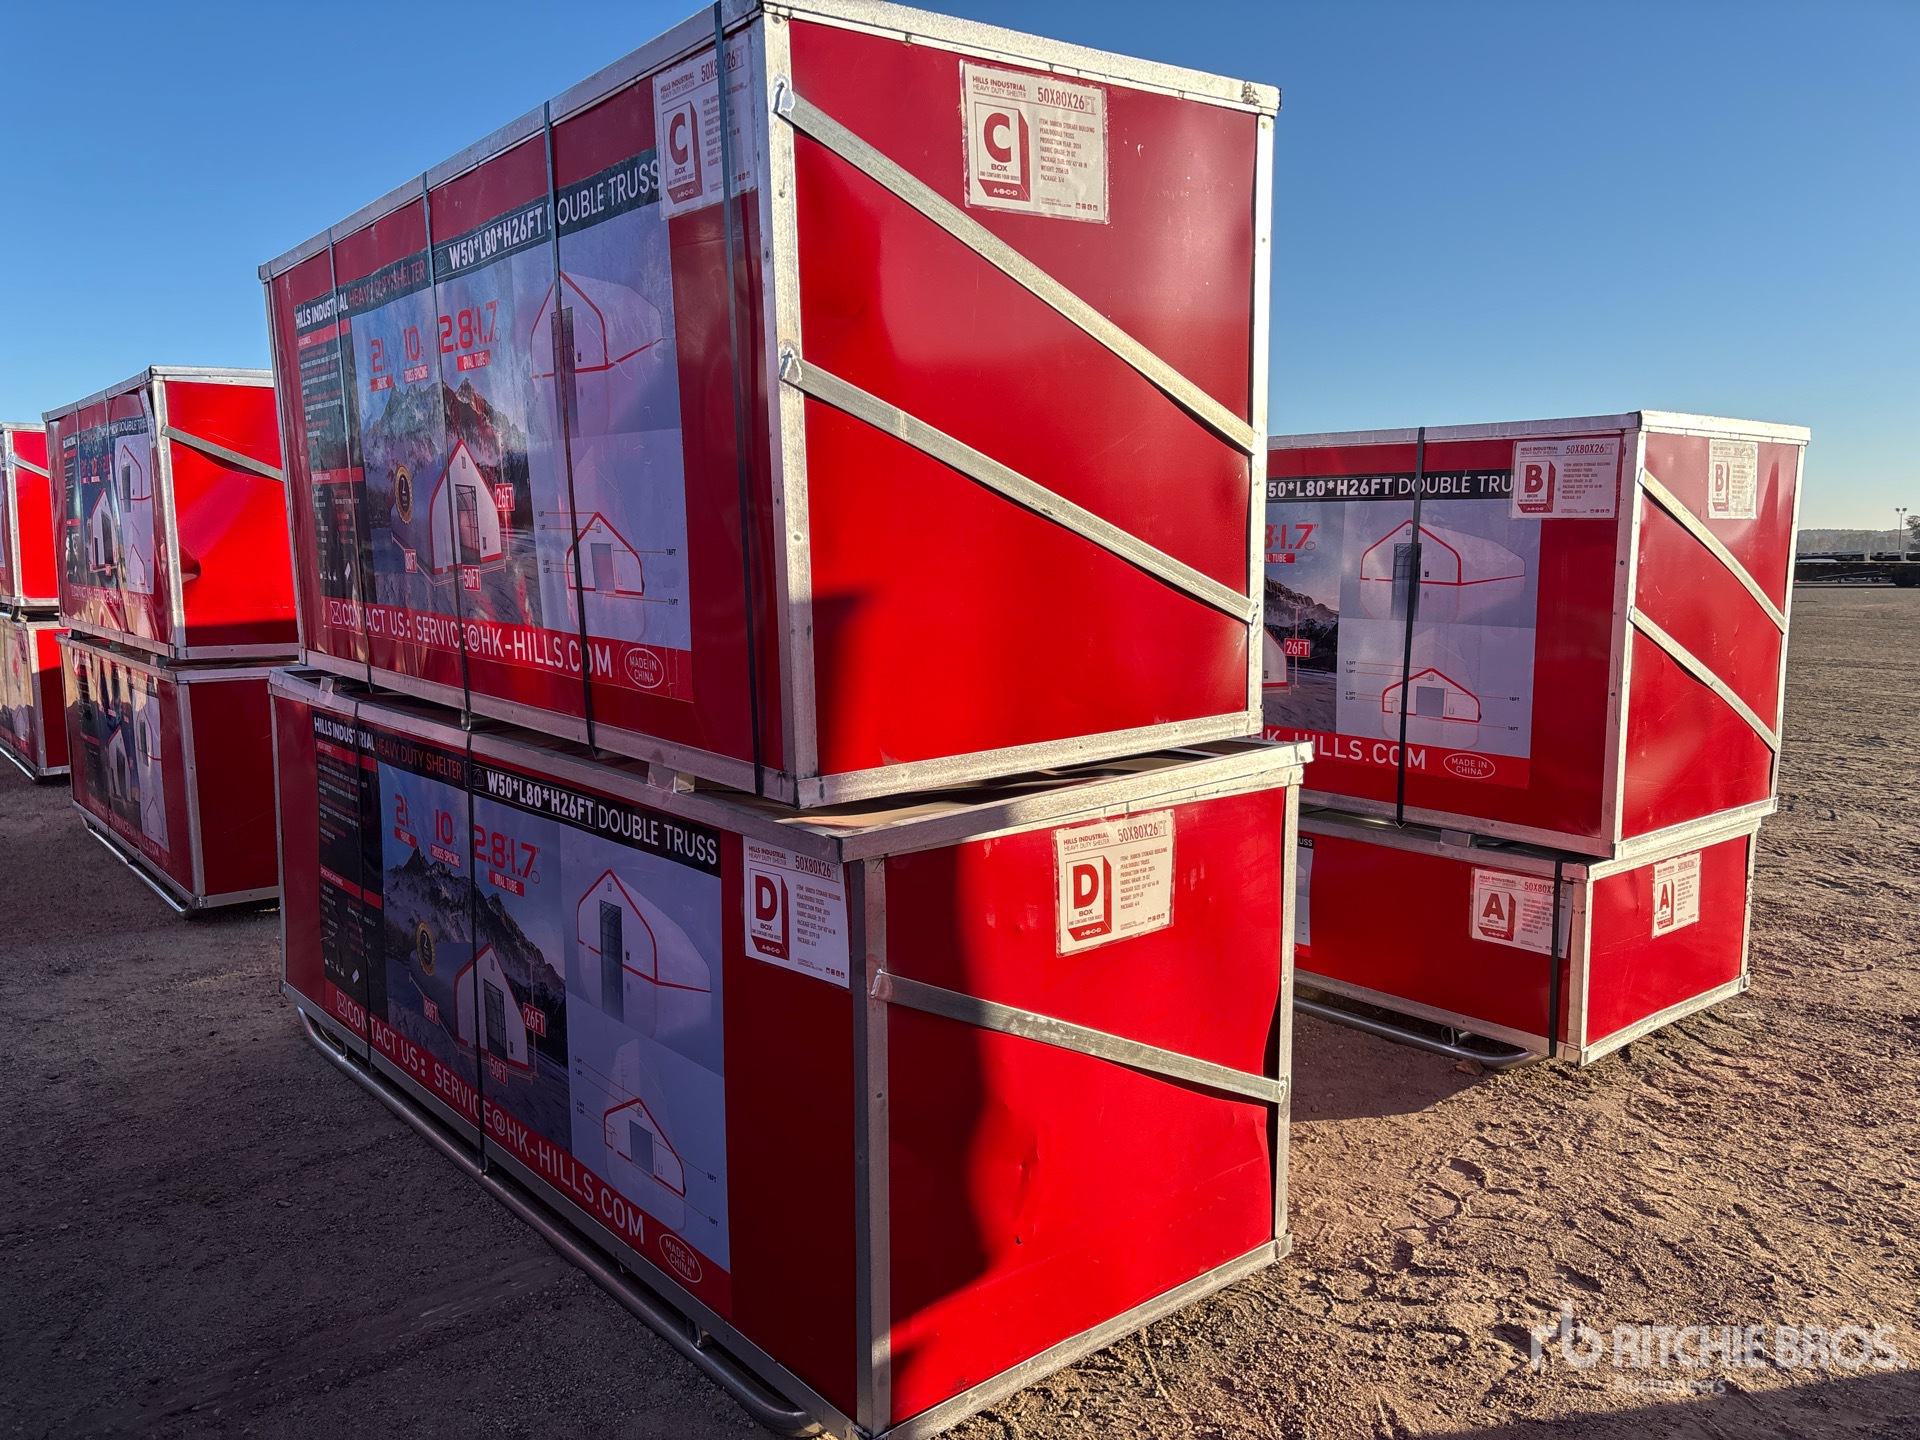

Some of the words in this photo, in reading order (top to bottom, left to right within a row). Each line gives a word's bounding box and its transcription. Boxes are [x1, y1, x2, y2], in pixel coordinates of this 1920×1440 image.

[701, 46, 744, 82] 50X826FT
[661, 83, 671, 94] HILLS
[671, 71, 695, 90] INDUSTRIAL
[973, 76, 989, 86] HILLS
[990, 79, 1027, 92] INDUSTRIAL
[973, 84, 990, 93] HEAVY
[990, 87, 1006, 96] DUTY
[1006, 89, 1027, 99] SHELTER
[1037, 86, 1096, 112] 50X80X26FT
[669, 112, 689, 166] C
[984, 113, 1012, 163] C
[1040, 137, 1062, 147] PRODUCTION
[1063, 131, 1074, 140] TRUSS
[1040, 145, 1053, 154] FABRIC
[1040, 156, 1056, 164] PACKAGE
[674, 166, 687, 176] BOX
[991, 163, 1008, 172] BOX
[311, 292, 349, 324] INDUSTIAL
[608, 160, 661, 206] TRUSS
[404, 325, 421, 361] 10
[370, 337, 386, 373] 21
[1566, 442, 1615, 455] 50X80X26FT
[1268, 478, 1393, 498] 50L80H26FT
[1398, 476, 1471, 494] DOUBLE
[1525, 464, 1544, 494] B
[1715, 463, 1725, 493] B
[496, 485, 514, 508] 26FT
[1272, 553, 1287, 563] TUBE
[464, 567, 481, 588] 50FT
[342, 603, 386, 633] CONACT
[1285, 640, 1310, 657] 26FT
[629, 655, 647, 670] MADE
[648, 659, 657, 671] IN
[633, 668, 655, 684] CHINA
[1451, 758, 1476, 768] MADE
[1478, 761, 1488, 770] IN
[1455, 766, 1483, 776] CHINA
[314, 716, 333, 737] HILLS
[333, 722, 375, 752] INDUSTRIAL
[376, 740, 401, 763] HEAVY
[401, 746, 424, 769] DUTY
[426, 752, 462, 781] SHELTER
[598, 804, 659, 847] DOUBLE
[664, 822, 717, 866] TRUSS
[394, 793, 409, 828] 21
[435, 808, 454, 846] 10
[1064, 837, 1078, 845] HILLS
[1078, 831, 1109, 842] INDUSTRIAL
[1118, 820, 1167, 843] 50X80X26FT
[749, 845, 761, 854] HILLS
[761, 848, 787, 860] INDUSTRIAL
[1064, 843, 1079, 851] HEAVY
[1080, 840, 1091, 849] DUTY
[1091, 837, 1110, 848] SHELTER
[749, 852, 761, 860] HEAVY
[761, 854, 772, 863] DUTY
[494, 873, 506, 889] OVAL
[506, 877, 518, 894] TUBE
[1073, 864, 1099, 910] D
[755, 874, 778, 922] D
[1482, 892, 1506, 921] A
[1659, 883, 1670, 912] A
[1078, 908, 1093, 917] BOX
[760, 922, 773, 931] BOX
[524, 1008, 545, 1035] 26FT
[490, 1058, 507, 1084] 50FT
[346, 1000, 397, 1056] CONTACT
[434, 1062, 645, 1245] SERVICE@HK-HILLS.COM
[665, 1238, 685, 1260] MADE
[686, 1255, 695, 1269] IN
[669, 1253, 692, 1279] CHINA
